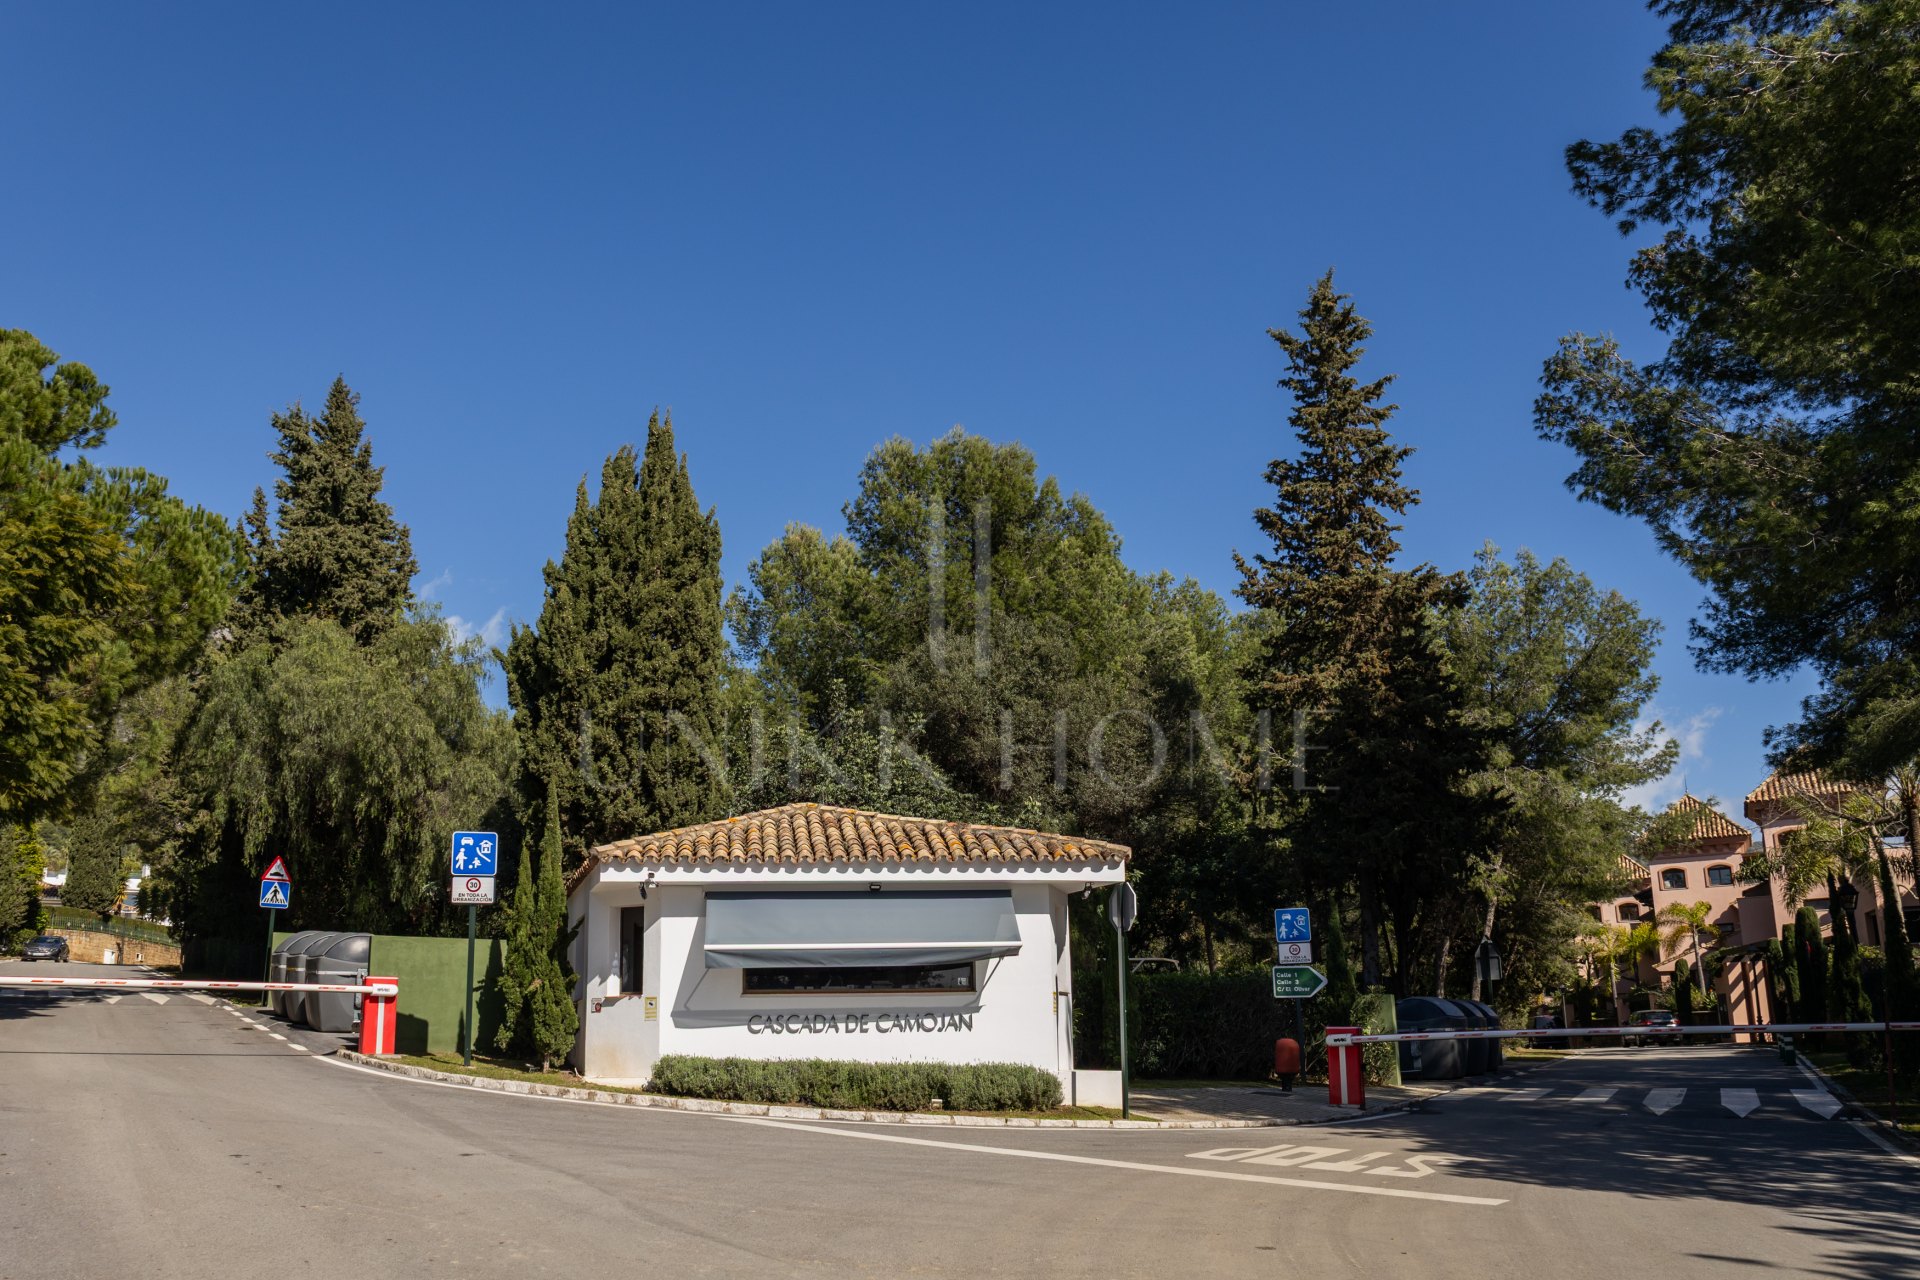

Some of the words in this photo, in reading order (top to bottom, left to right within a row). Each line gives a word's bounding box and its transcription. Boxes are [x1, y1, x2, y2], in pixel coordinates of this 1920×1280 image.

[747, 1014, 840, 1035] CASCADA
[845, 1014, 870, 1034] DE
[875, 1012, 973, 1033] CAMOJAN
[1184, 1144, 1486, 1178] STOP
